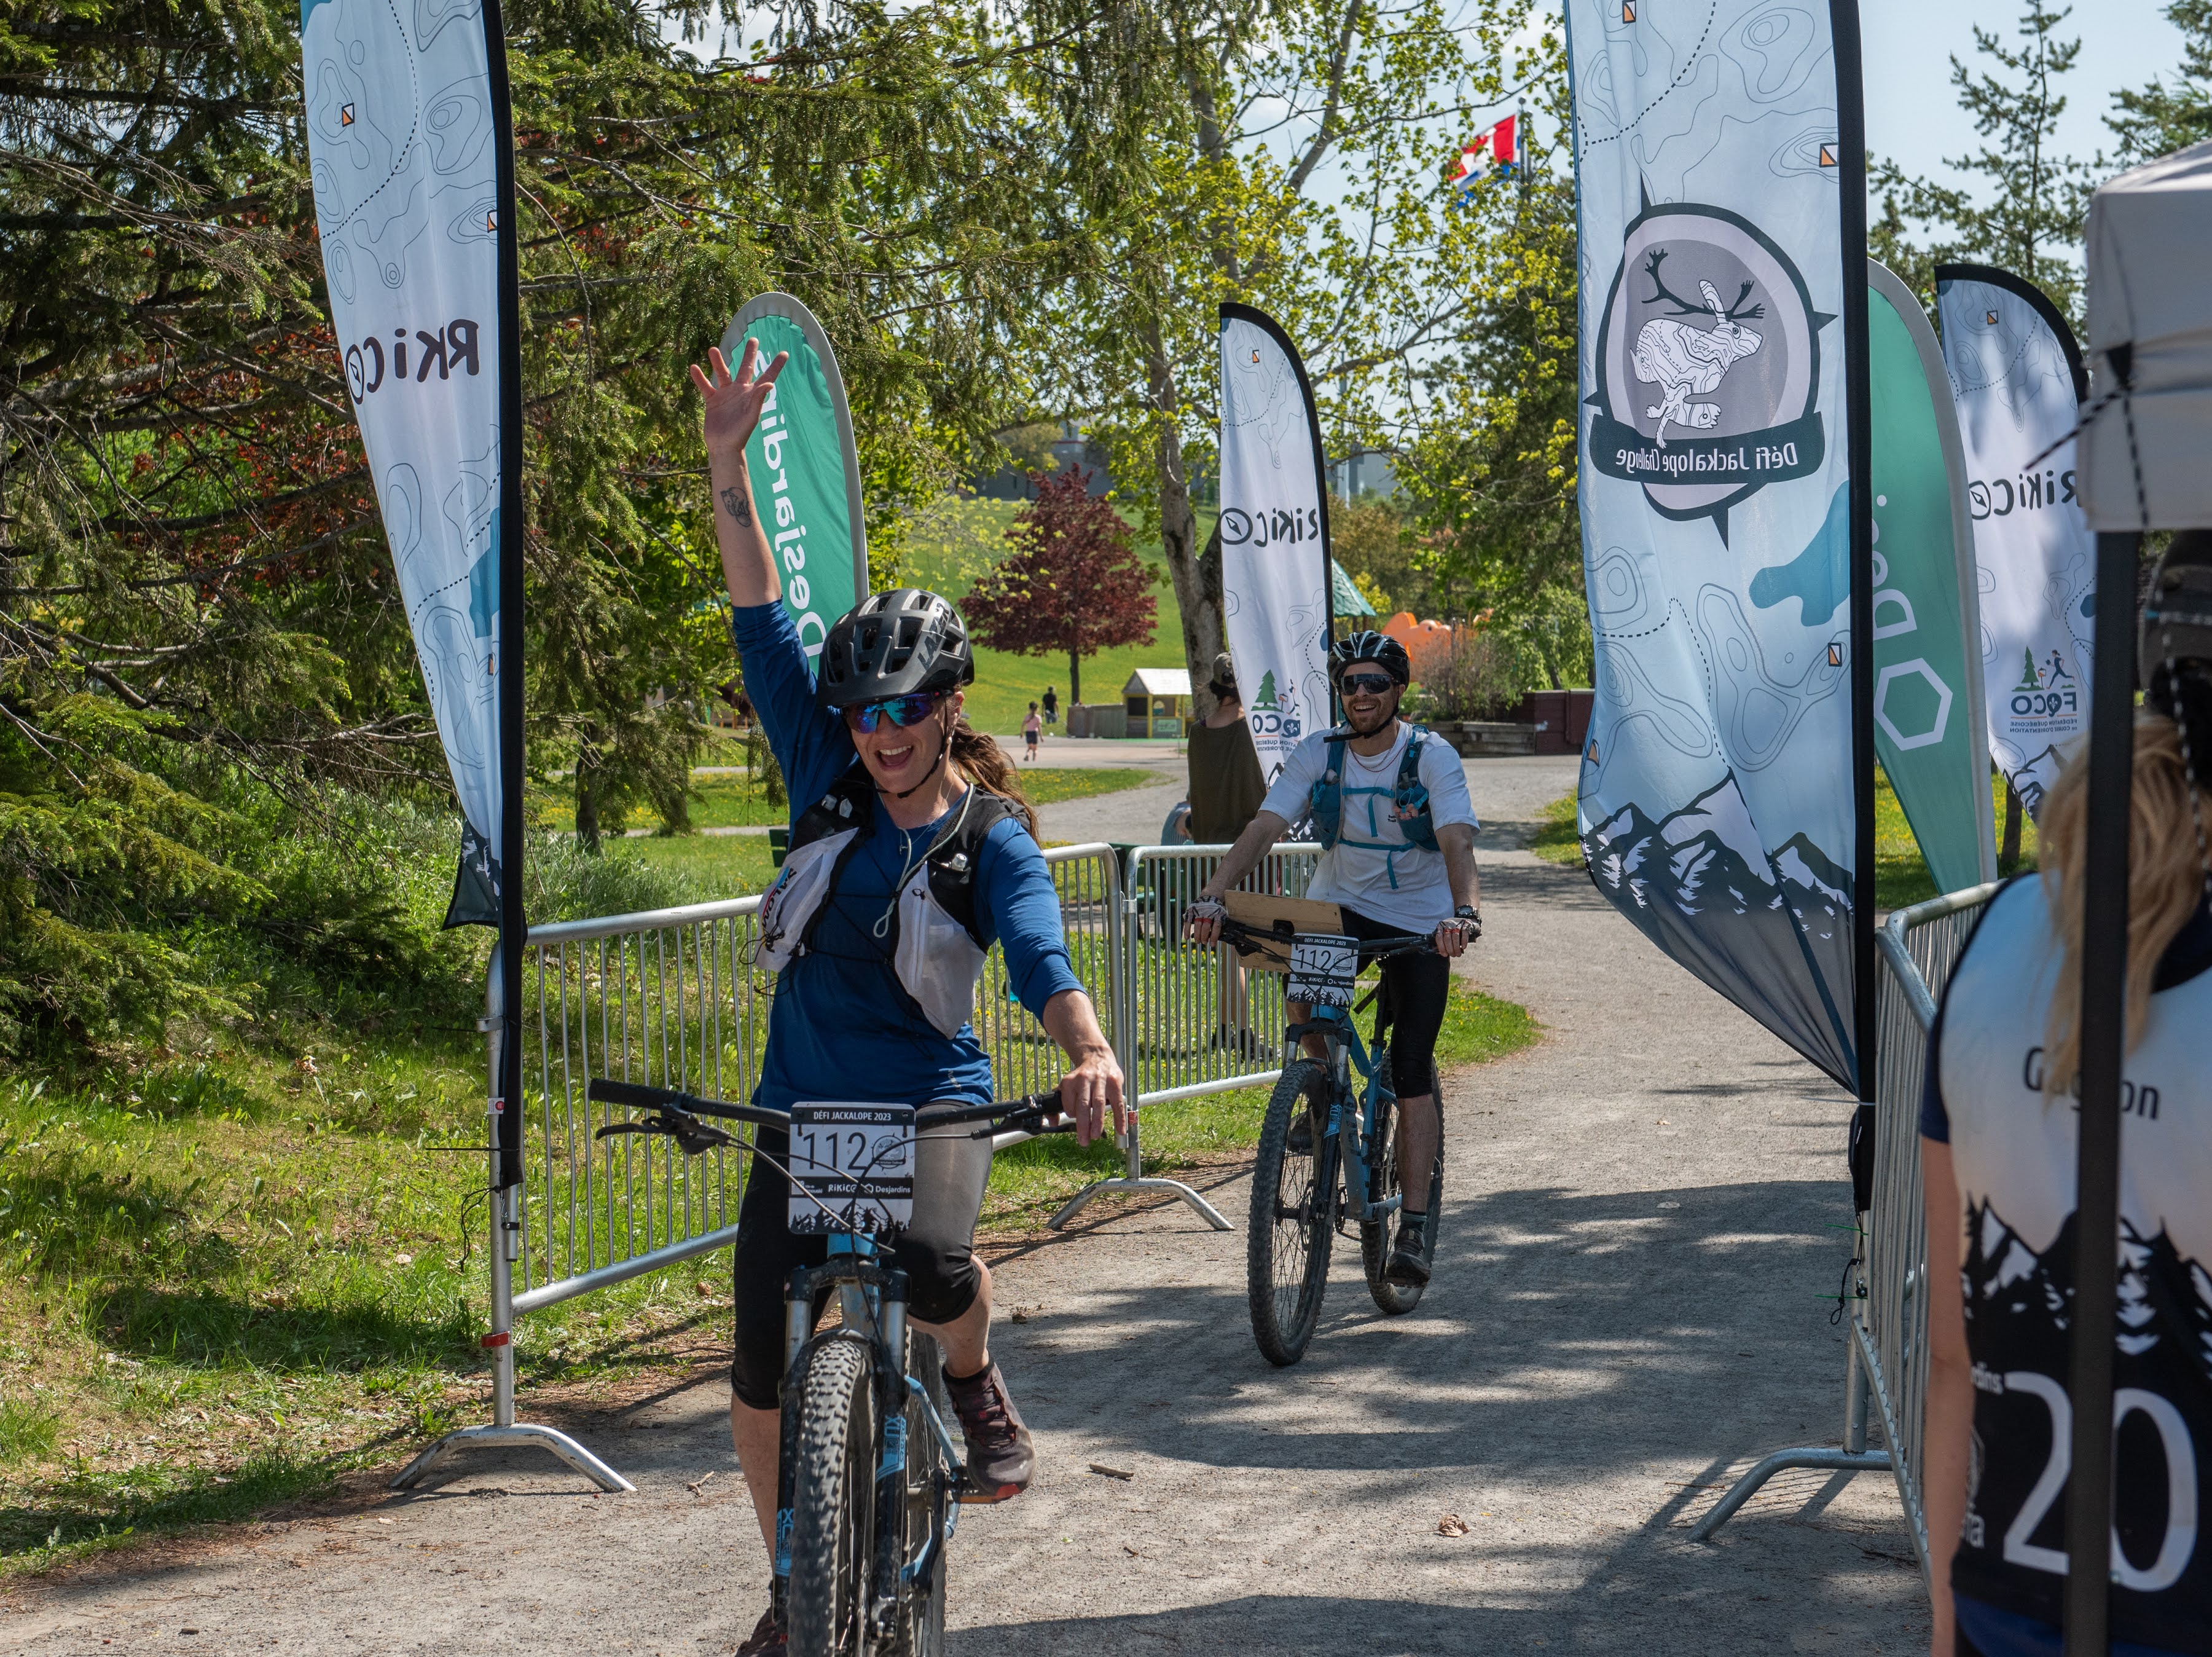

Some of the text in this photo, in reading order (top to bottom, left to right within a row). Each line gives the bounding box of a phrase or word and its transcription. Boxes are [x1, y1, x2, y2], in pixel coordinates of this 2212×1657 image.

[1298, 948, 1332, 971] 112
[814, 1109, 892, 1120] DÉFI JACKALOPE 2023
[803, 1132, 870, 1170] 112
[875, 1185, 911, 1195] Desjardins
[2003, 1371, 2198, 1592] 20
